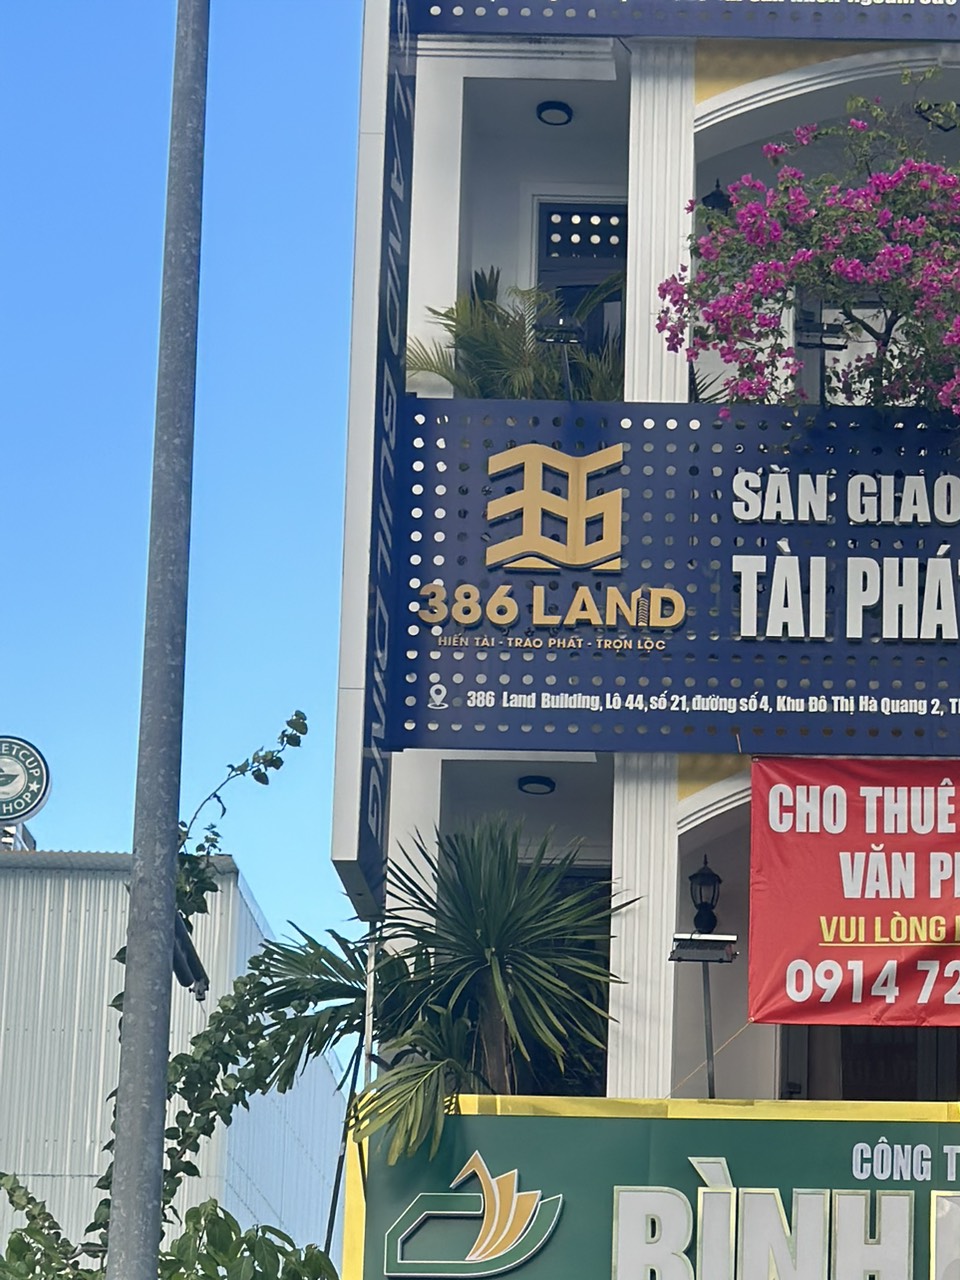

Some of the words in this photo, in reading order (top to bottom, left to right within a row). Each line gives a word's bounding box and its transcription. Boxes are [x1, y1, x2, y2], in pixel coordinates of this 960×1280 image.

[732, 464, 828, 522] SÀN
[417, 583, 519, 627] 386
[532, 585, 686, 629] LAND
[732, 538, 827, 638] TÀI
[508, 637, 543, 649] TRAO
[467, 691, 495, 707] 386
[503, 691, 536, 708] Land
[541, 692, 603, 712] Building,
[605, 692, 621, 709] Lô
[625, 694, 648, 712] 44,
[650, 689, 667, 710] số
[671, 695, 690, 713] 21,
[692, 692, 737, 713] đường
[776, 696, 804, 712] Khu
[808, 694, 827, 712] Đô
[832, 695, 854, 717] Thị
[859, 694, 877, 712] Hà
[881, 698, 927, 716] Quang
[931, 699, 944, 717] 2,
[0, 743, 41, 777] ETCUP
[0, 792, 32, 814] HOP
[768, 783, 847, 833] CHO
[859, 778, 956, 833] THUÊ
[839, 843, 915, 898] VĂN
[819, 915, 865, 942] VUI
[874, 911, 945, 942] LÒNG
[786, 960, 899, 1003] 0914
[852, 1136, 931, 1181] CÔNG
